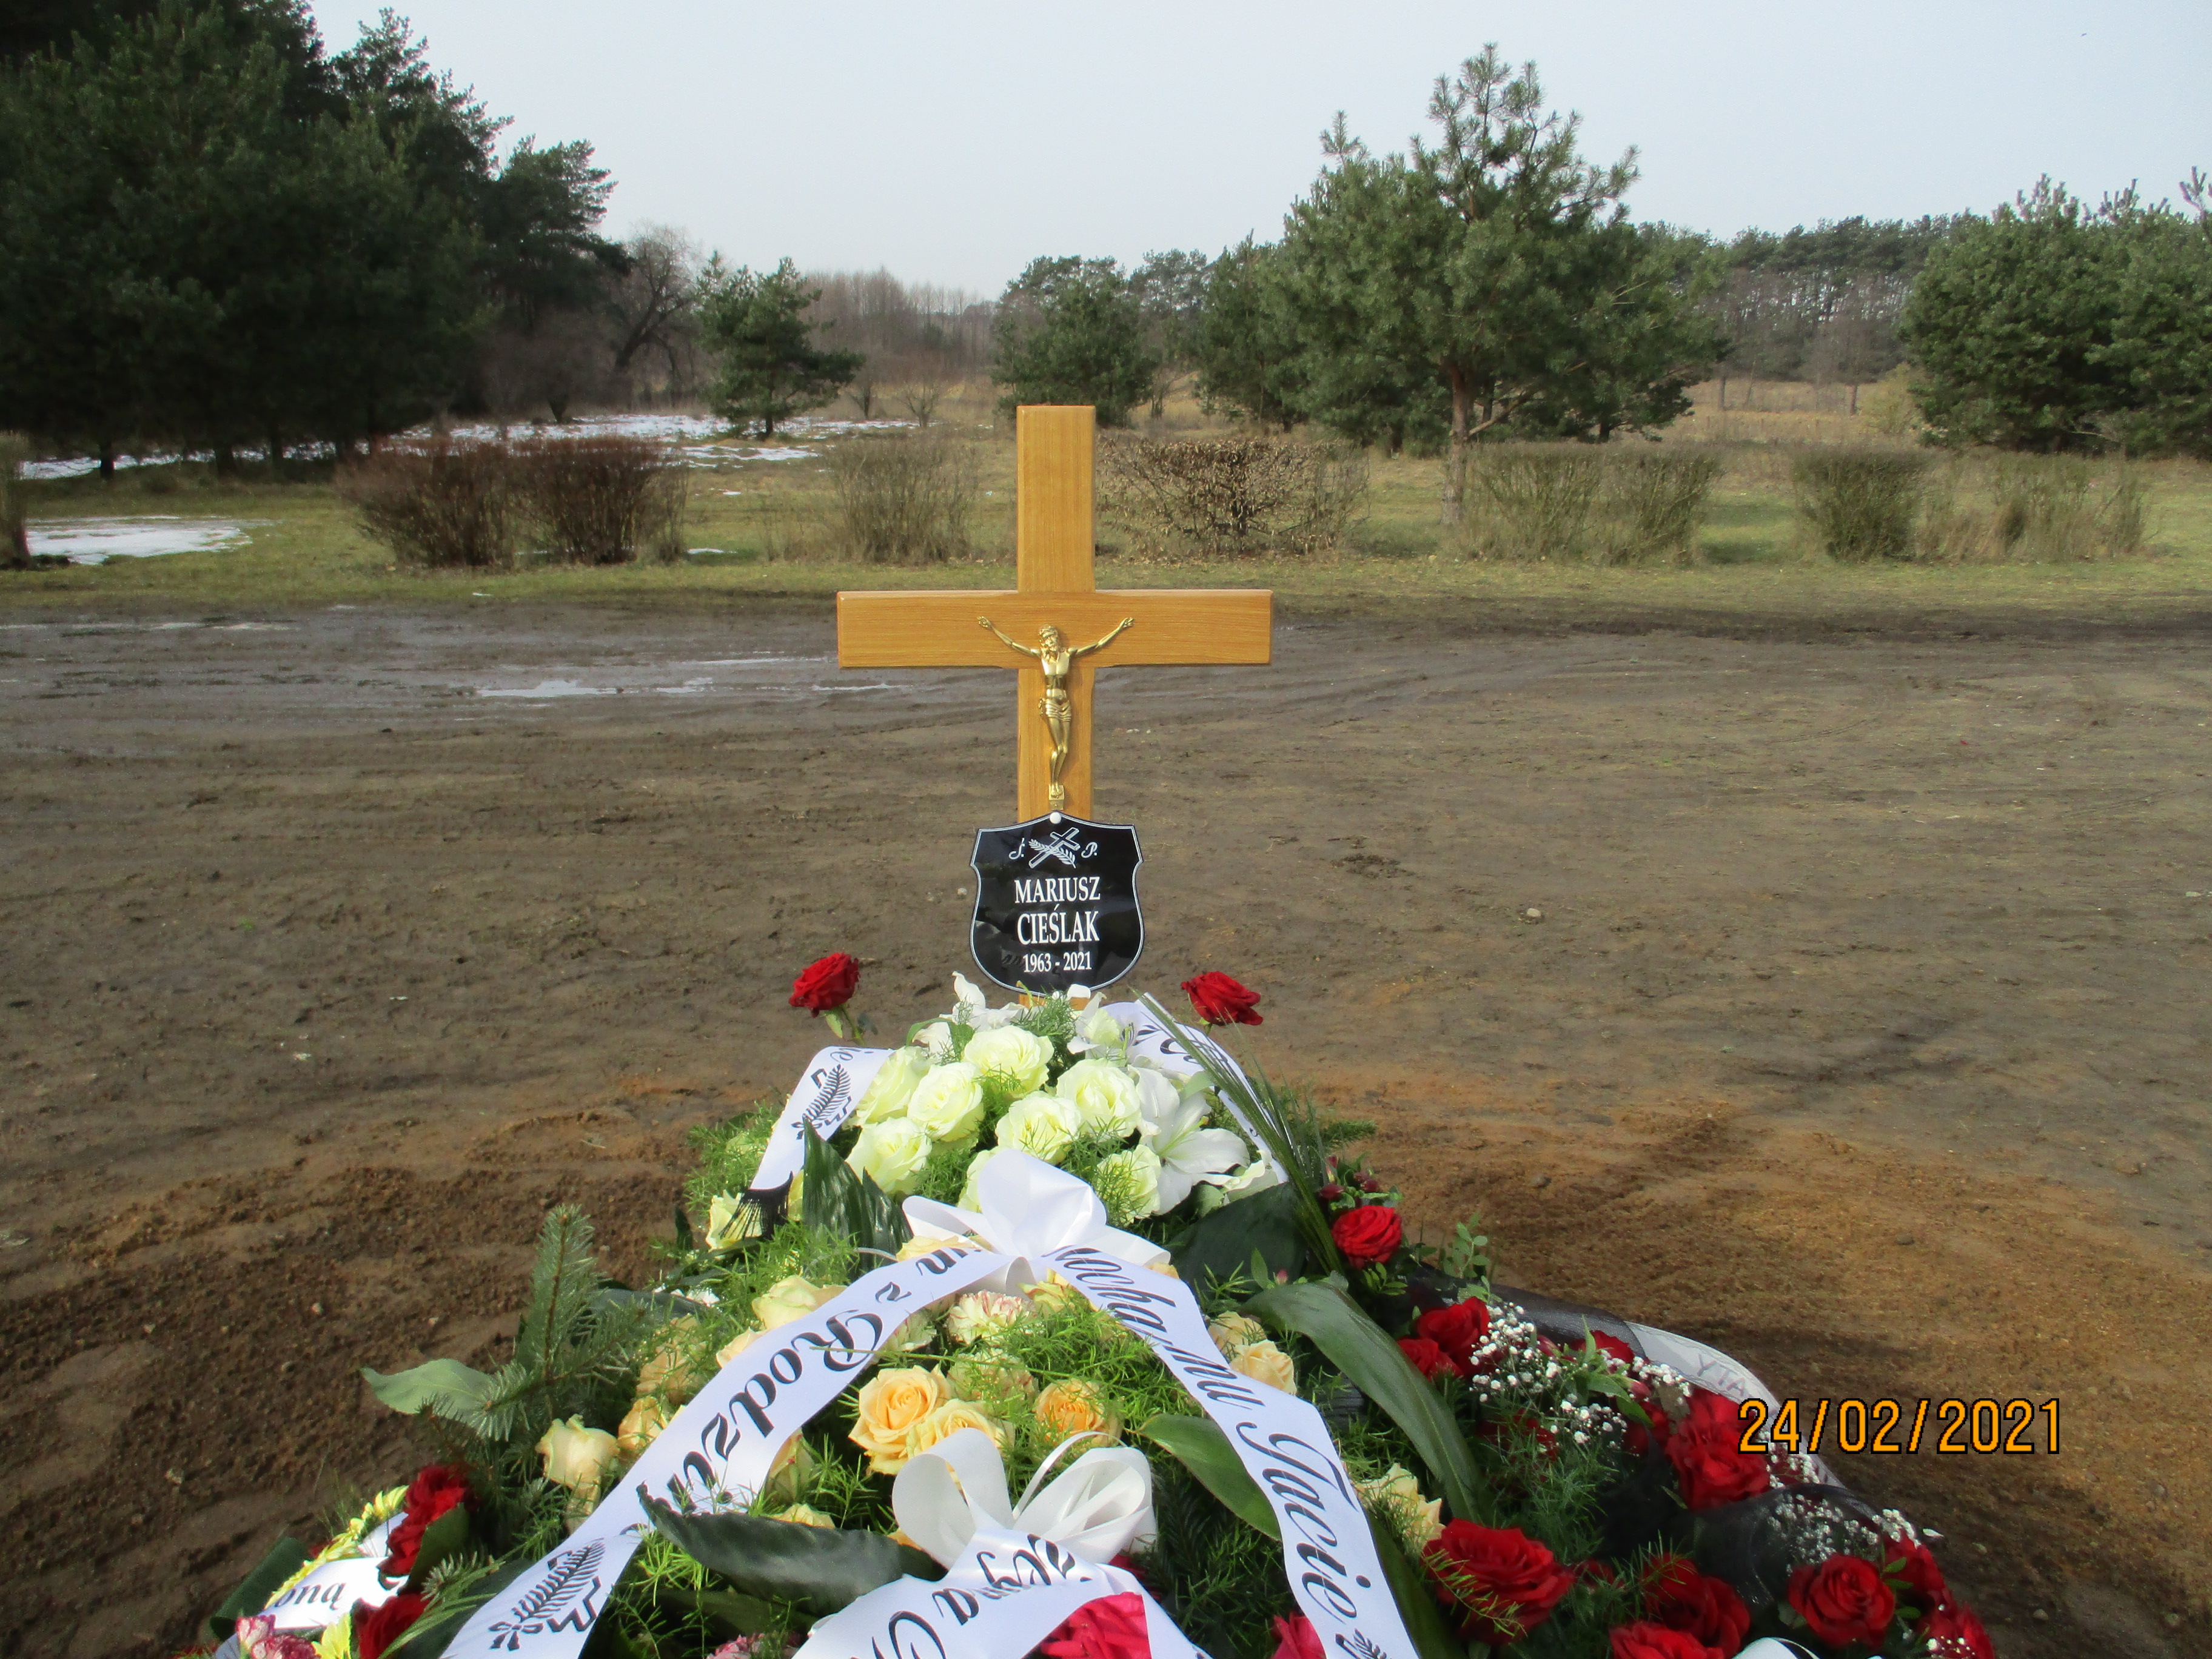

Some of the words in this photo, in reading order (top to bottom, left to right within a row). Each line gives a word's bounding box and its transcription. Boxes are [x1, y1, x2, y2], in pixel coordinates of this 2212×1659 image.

[1014, 877, 1101, 903] MARIUSZ
[1017, 903, 1101, 945] CIEŚLAK
[1022, 953, 1052, 973] 1963
[1062, 951, 1092, 971] 2021
